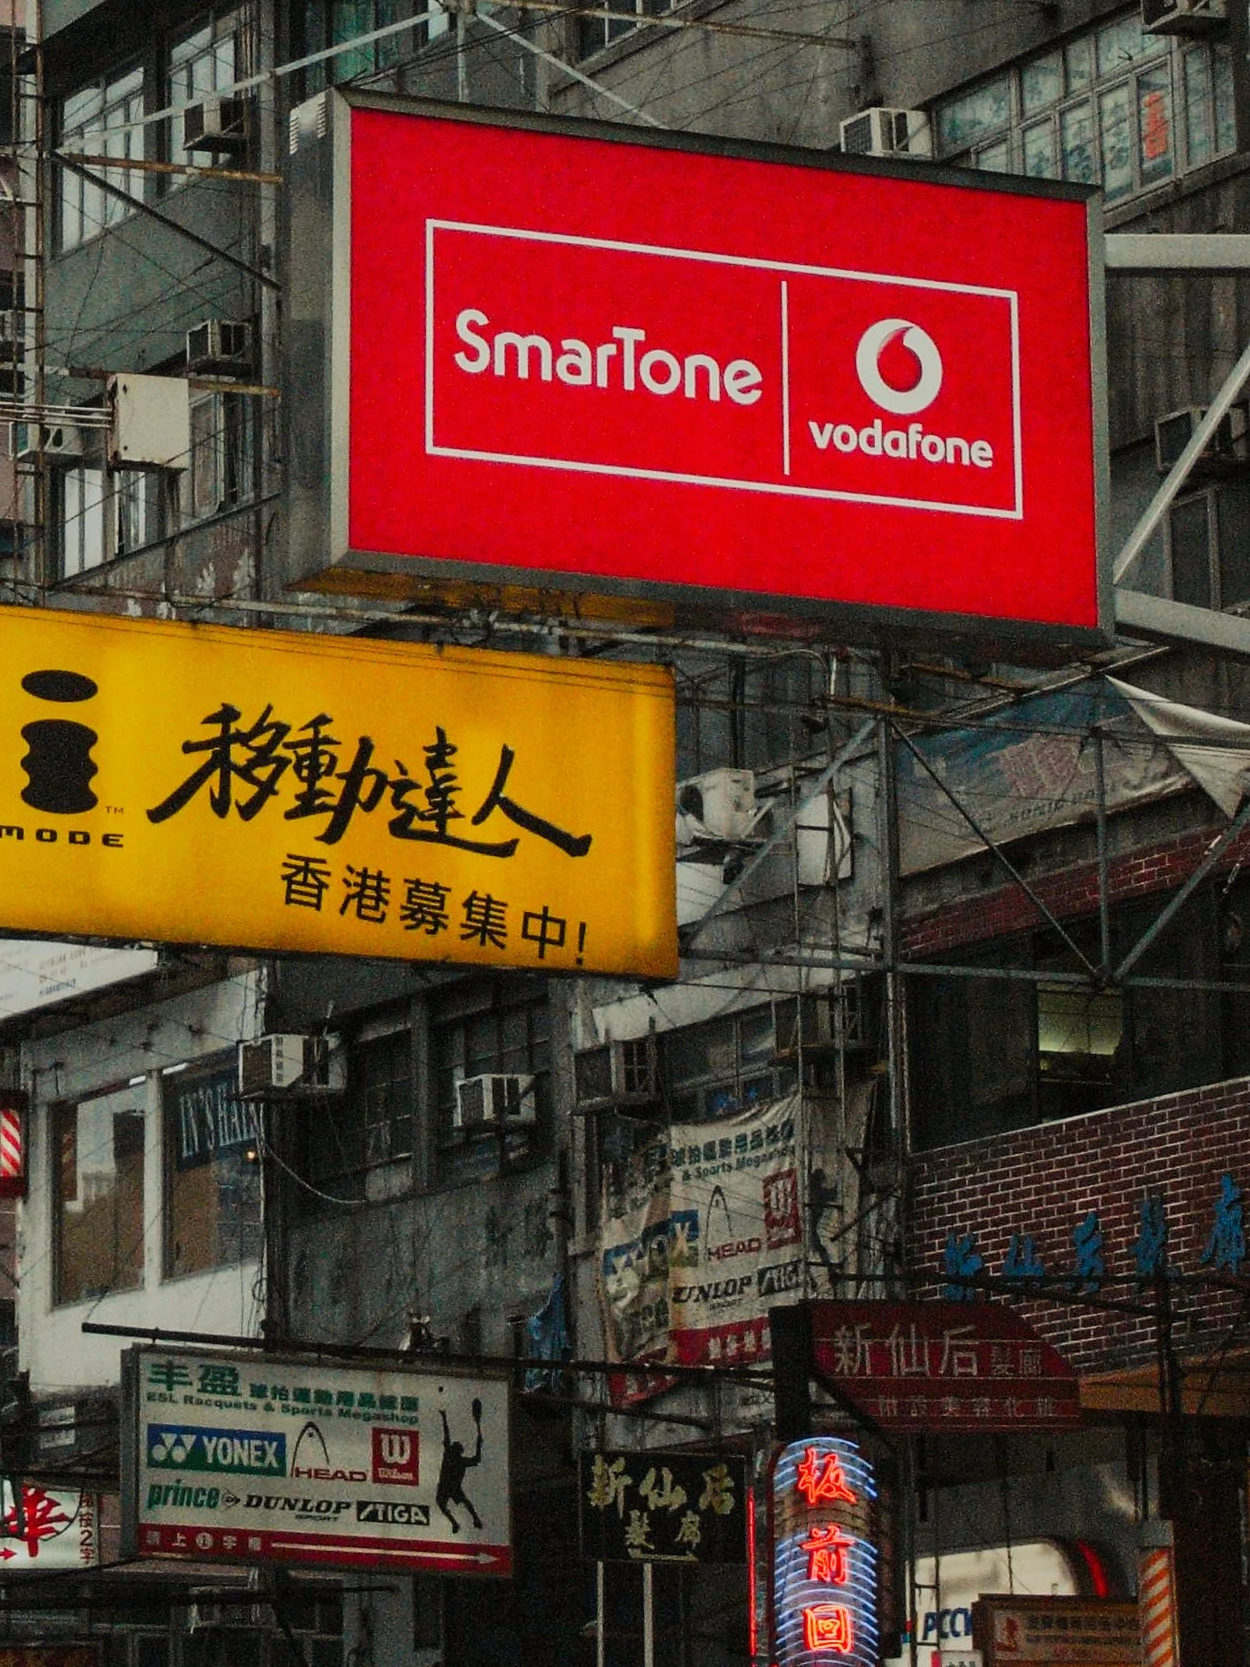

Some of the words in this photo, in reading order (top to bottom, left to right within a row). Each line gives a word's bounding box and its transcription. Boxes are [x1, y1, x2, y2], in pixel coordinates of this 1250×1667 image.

[455, 308, 763, 406] SmarTone
[809, 419, 993, 468] vodafone
[148, 703, 592, 859] 移動達人
[709, 1237, 761, 1261] HEAD
[673, 1275, 752, 1303] UNLOP
[146, 1392, 177, 1404] ESL
[184, 1395, 257, 1410] Racquets
[263, 1401, 274, 1412] &
[281, 1403, 332, 1417] Sports
[338, 1408, 419, 1425] Megashop
[204, 1435, 279, 1469] YONEX
[295, 1466, 368, 1482] HEAD
[147, 1478, 219, 1511] prince
[244, 1494, 352, 1514] DUNLOP
